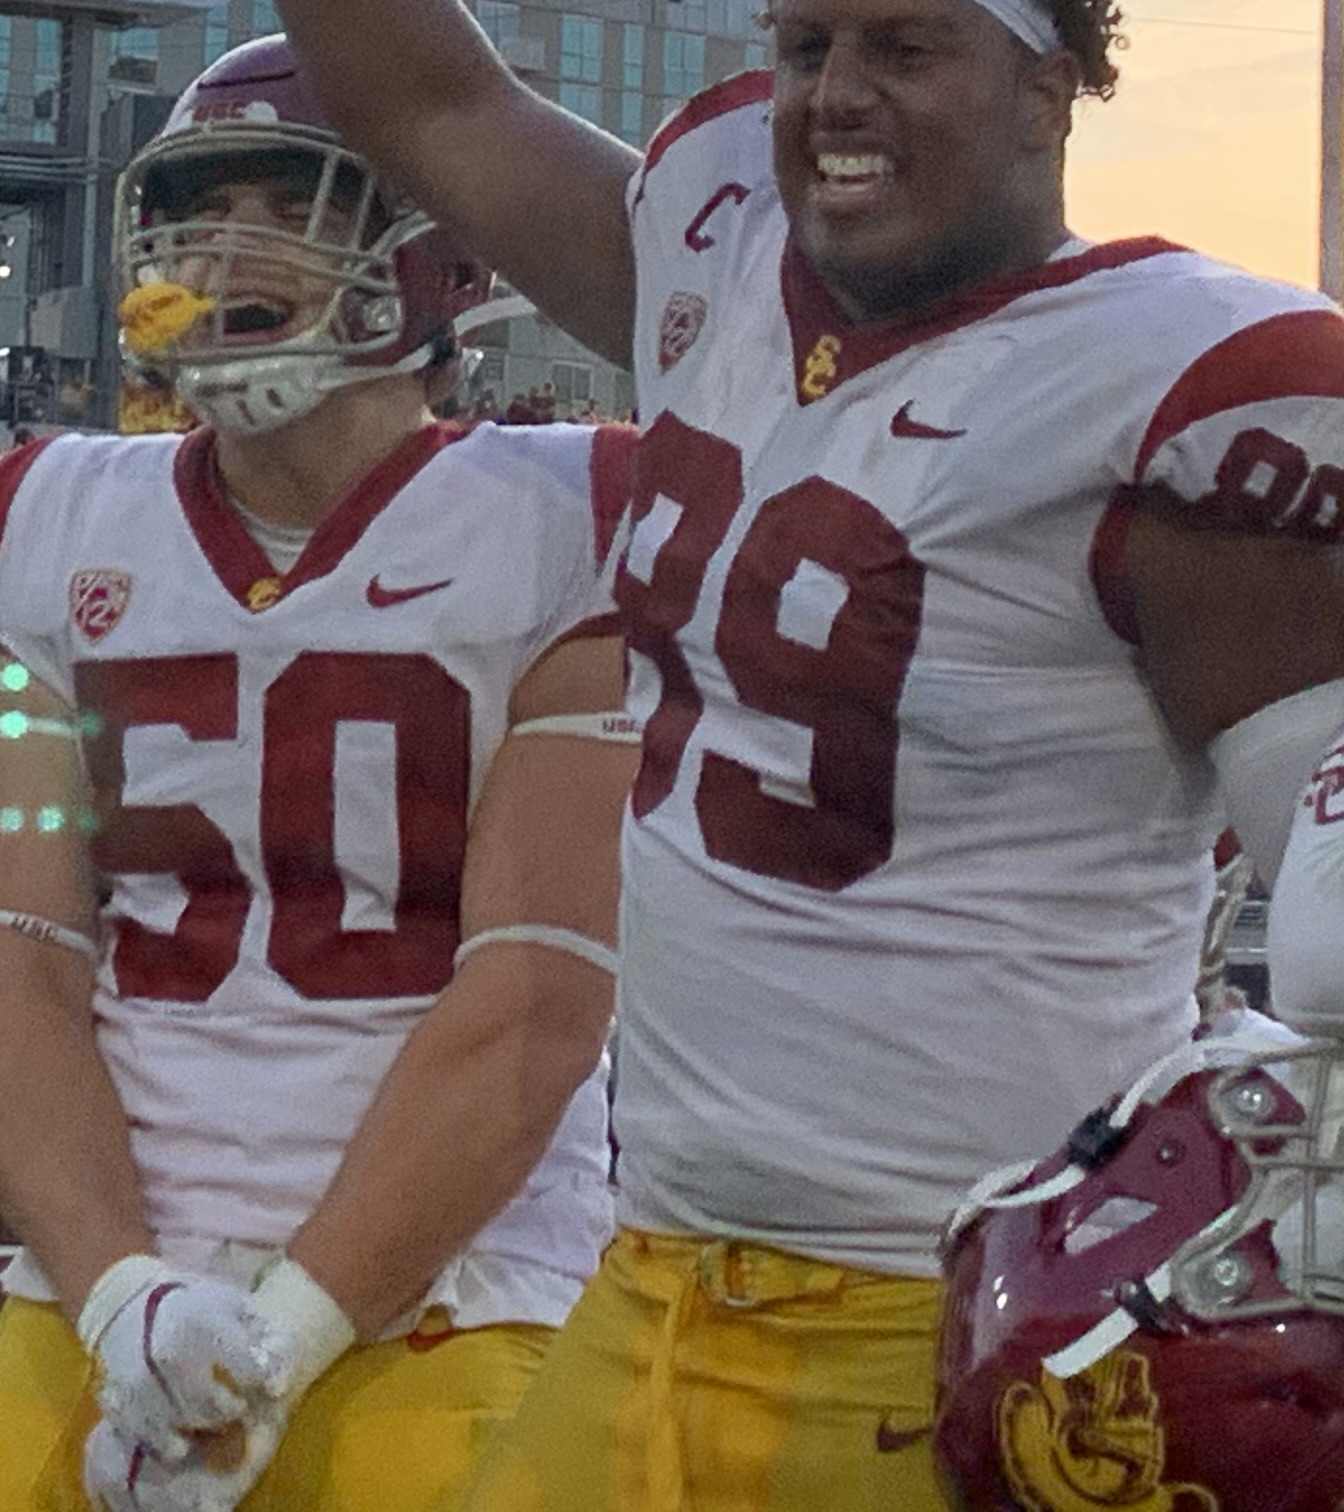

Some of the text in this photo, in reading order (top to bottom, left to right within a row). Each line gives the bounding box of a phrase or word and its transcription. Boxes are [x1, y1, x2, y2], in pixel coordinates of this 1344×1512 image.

[685, 182, 751, 254] C
[73, 649, 472, 1002] 50
[616, 408, 927, 892] 89
